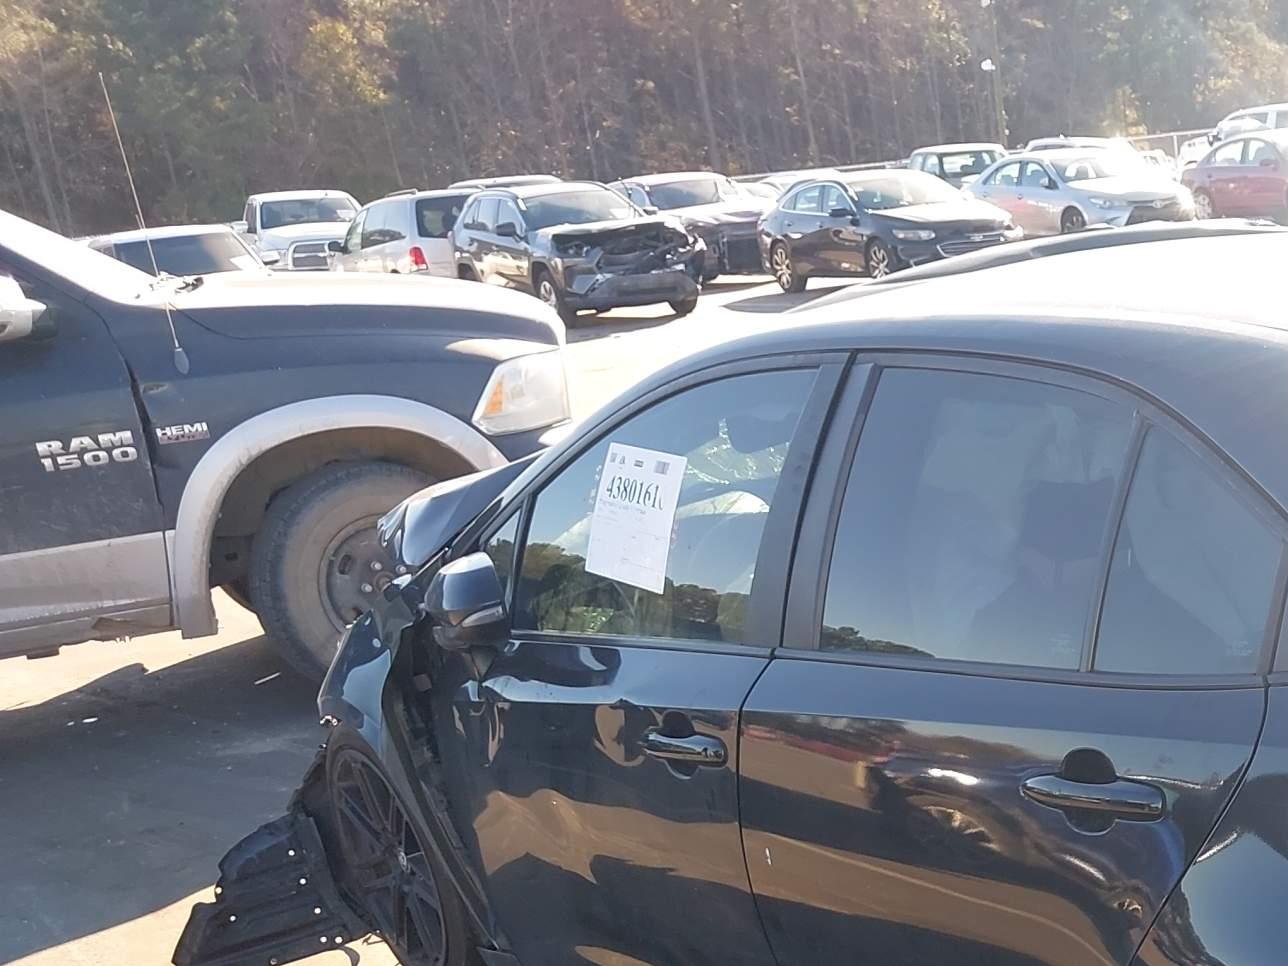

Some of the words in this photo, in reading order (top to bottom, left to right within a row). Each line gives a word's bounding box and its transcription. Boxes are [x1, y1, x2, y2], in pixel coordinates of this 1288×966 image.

[156, 421, 208, 437] HEMI
[35, 430, 134, 457] RAM
[40, 446, 138, 472] 1500
